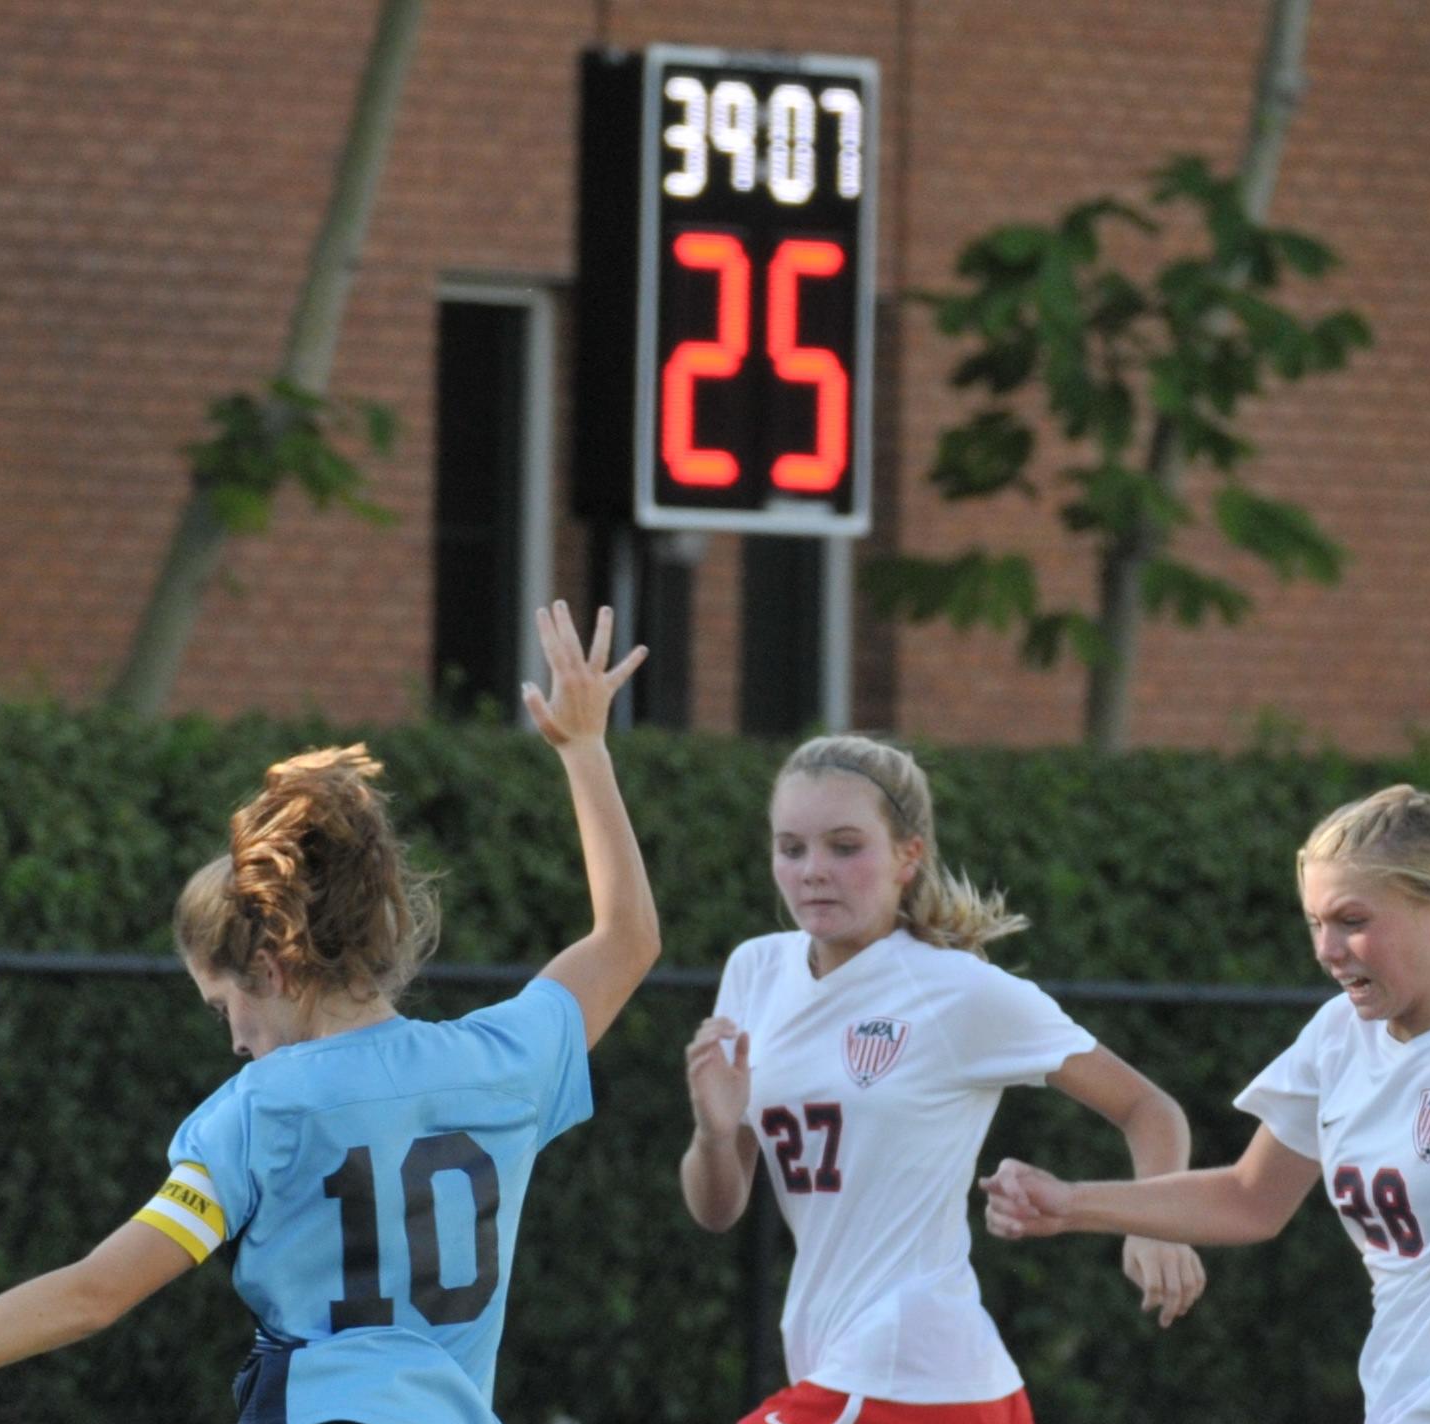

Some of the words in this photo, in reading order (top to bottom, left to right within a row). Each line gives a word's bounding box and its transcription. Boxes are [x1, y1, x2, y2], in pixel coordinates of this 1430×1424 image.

[662, 231, 848, 491] 25
[323, 1131, 500, 1334] 10
[761, 1102, 843, 1194] 27
